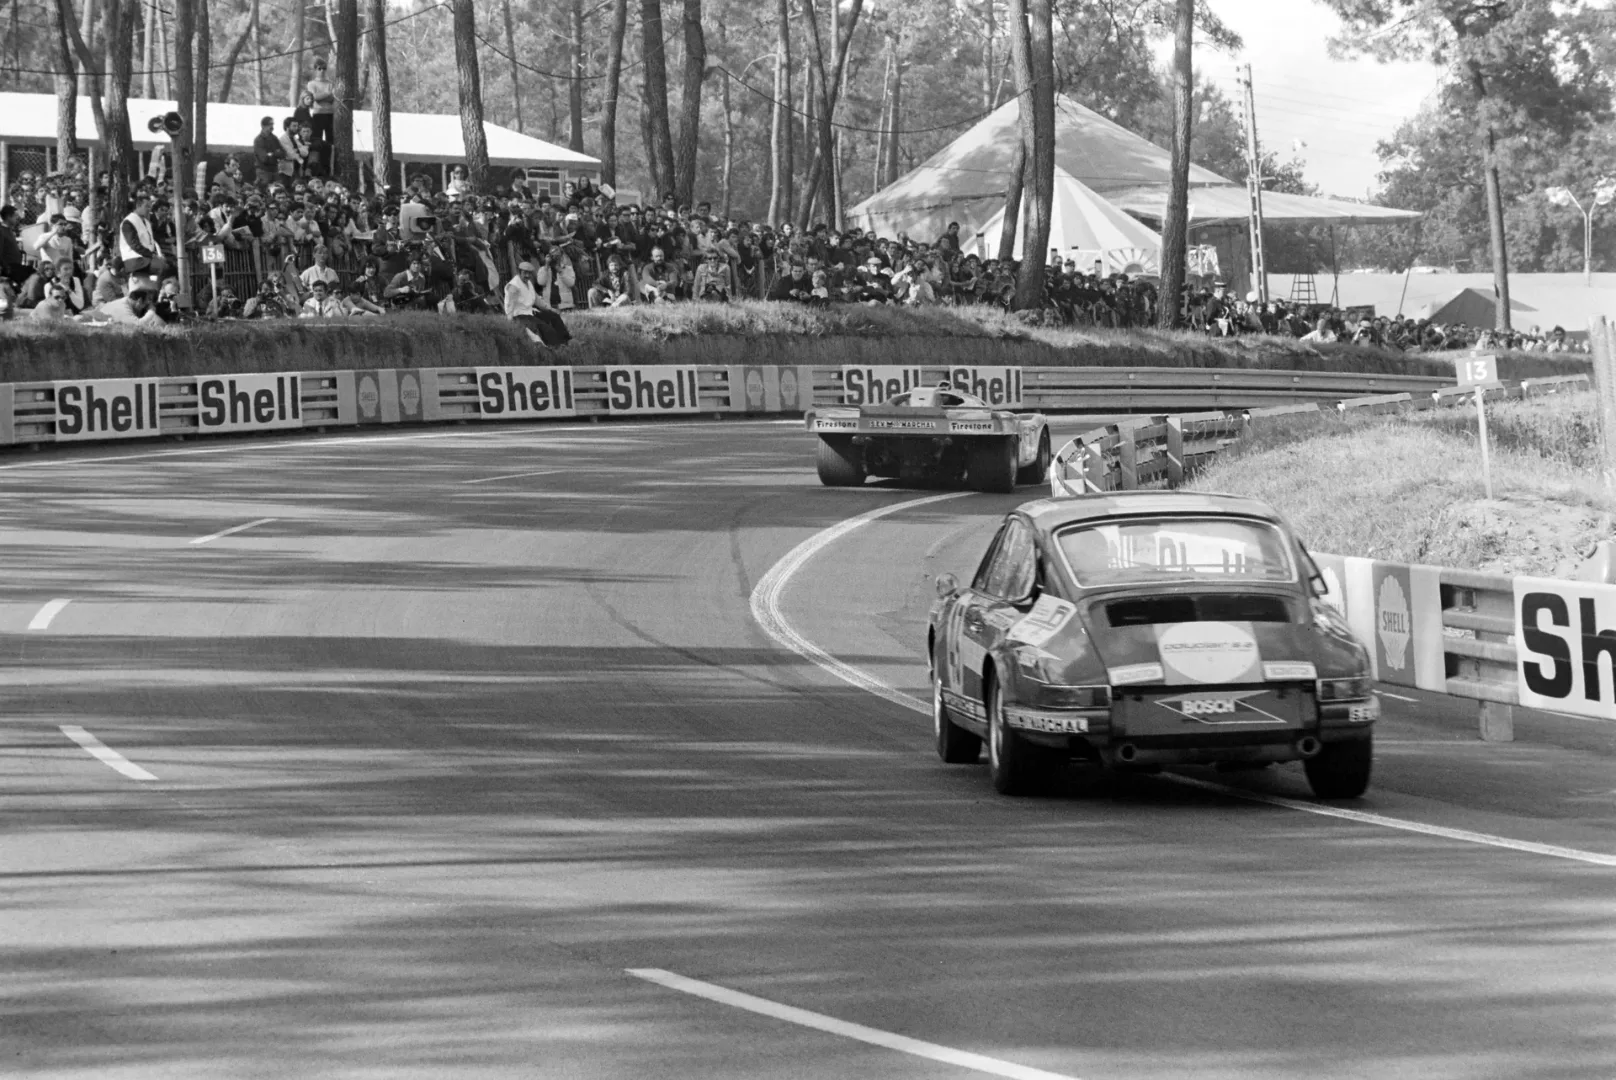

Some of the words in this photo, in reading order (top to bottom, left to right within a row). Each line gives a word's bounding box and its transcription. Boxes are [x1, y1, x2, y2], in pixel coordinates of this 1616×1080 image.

[1466, 361, 1488, 381] 13
[201, 376, 299, 426] Shell
[480, 370, 573, 414] Shell
[610, 369, 697, 410] Shell
[845, 368, 919, 405] Shell
[953, 368, 1021, 405] Shell
[58, 383, 157, 435] Shell
[816, 420, 857, 428] Firestone
[901, 421, 936, 429] MARCHAL
[951, 422, 993, 430] Firestone
[1382, 610, 1406, 634] SHELL
[1181, 700, 1235, 714] BOSCH
